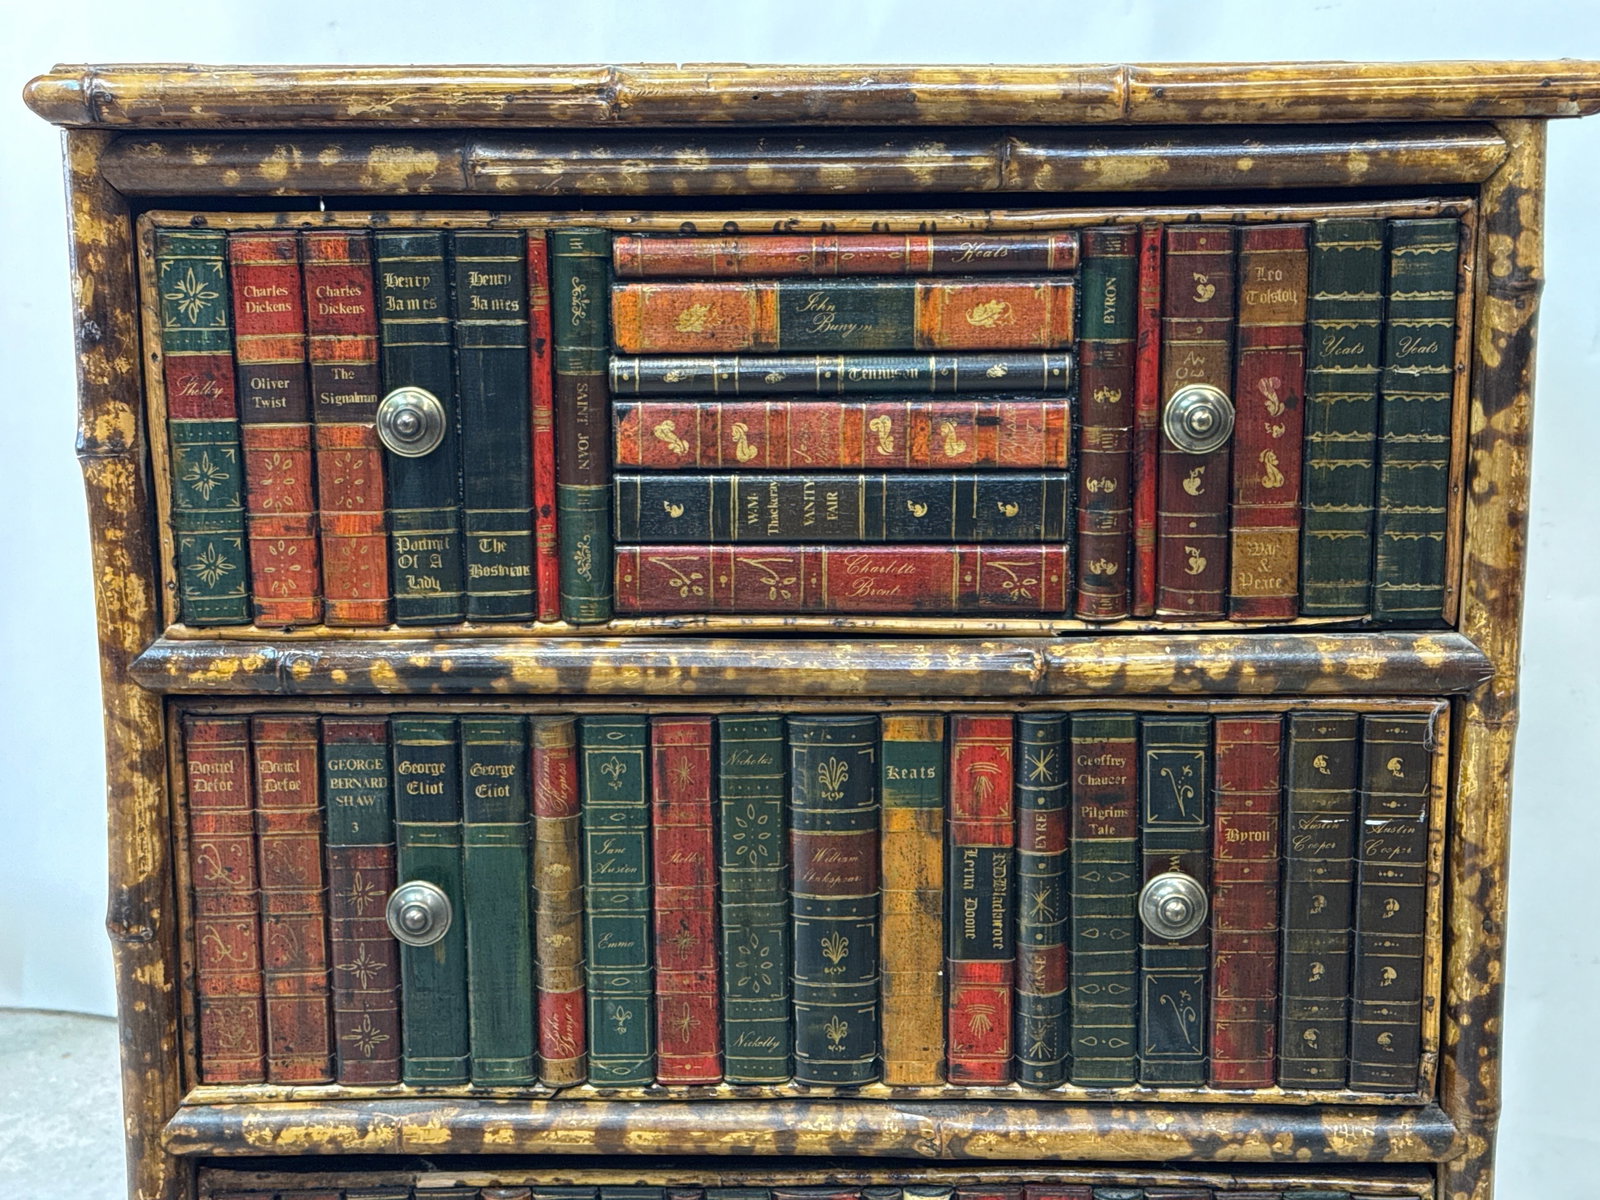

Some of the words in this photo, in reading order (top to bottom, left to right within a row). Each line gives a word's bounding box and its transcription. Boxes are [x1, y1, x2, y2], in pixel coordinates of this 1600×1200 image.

[952, 242, 1008, 263] Keats
[383, 272, 431, 290] Henry
[468, 271, 512, 289] Henry
[1254, 266, 1283, 281] Leo
[244, 285, 289, 297] Charles
[316, 286, 361, 298] Charles
[1246, 289, 1297, 305] Tolstoy
[246, 301, 292, 314] Dickens
[385, 296, 438, 312] James
[470, 295, 519, 312] James
[1103, 276, 1117, 324] BYRON
[319, 303, 365, 315] Dickens
[1319, 335, 1365, 358] Yeats
[1396, 335, 1439, 358] Yeats
[331, 368, 355, 380] The
[251, 378, 290, 389] Oliver
[252, 397, 287, 409] Twist
[320, 391, 378, 406] Signalman
[576, 382, 589, 426] SAINT
[577, 433, 591, 471] JOAN
[747, 492, 759, 525] W.M.
[767, 480, 780, 536] Thackeray
[803, 480, 816, 526] VANITY
[826, 491, 839, 522] FAIR
[479, 539, 507, 554] The
[398, 554, 418, 568] Of
[430, 554, 442, 568] A
[844, 554, 916, 575] Charlotte
[1257, 558, 1272, 572] &
[406, 575, 441, 591] Lady
[188, 760, 235, 776] Daniel
[260, 760, 301, 774] Daniel
[328, 759, 384, 771] GEORGE
[399, 760, 447, 776] George
[1077, 754, 1126, 769] Geoffrey
[470, 763, 516, 779] George
[886, 765, 937, 780] Keats
[193, 778, 234, 793] Defoe
[264, 778, 302, 793] Defoe
[330, 777, 387, 789] BERNARD
[1078, 774, 1127, 785] Chaucer
[406, 780, 445, 795] Eliot
[475, 784, 511, 798] Eliot
[335, 795, 377, 806] SHAW
[1081, 805, 1128, 819] Pilgrims
[351, 821, 360, 833] 3
[1035, 813, 1047, 850] EYRE
[1089, 824, 1116, 835] Tale
[1366, 818, 1416, 835] Austin
[1225, 828, 1270, 844] Byron
[963, 897, 979, 939] Doone
[597, 932, 635, 949] Emma
